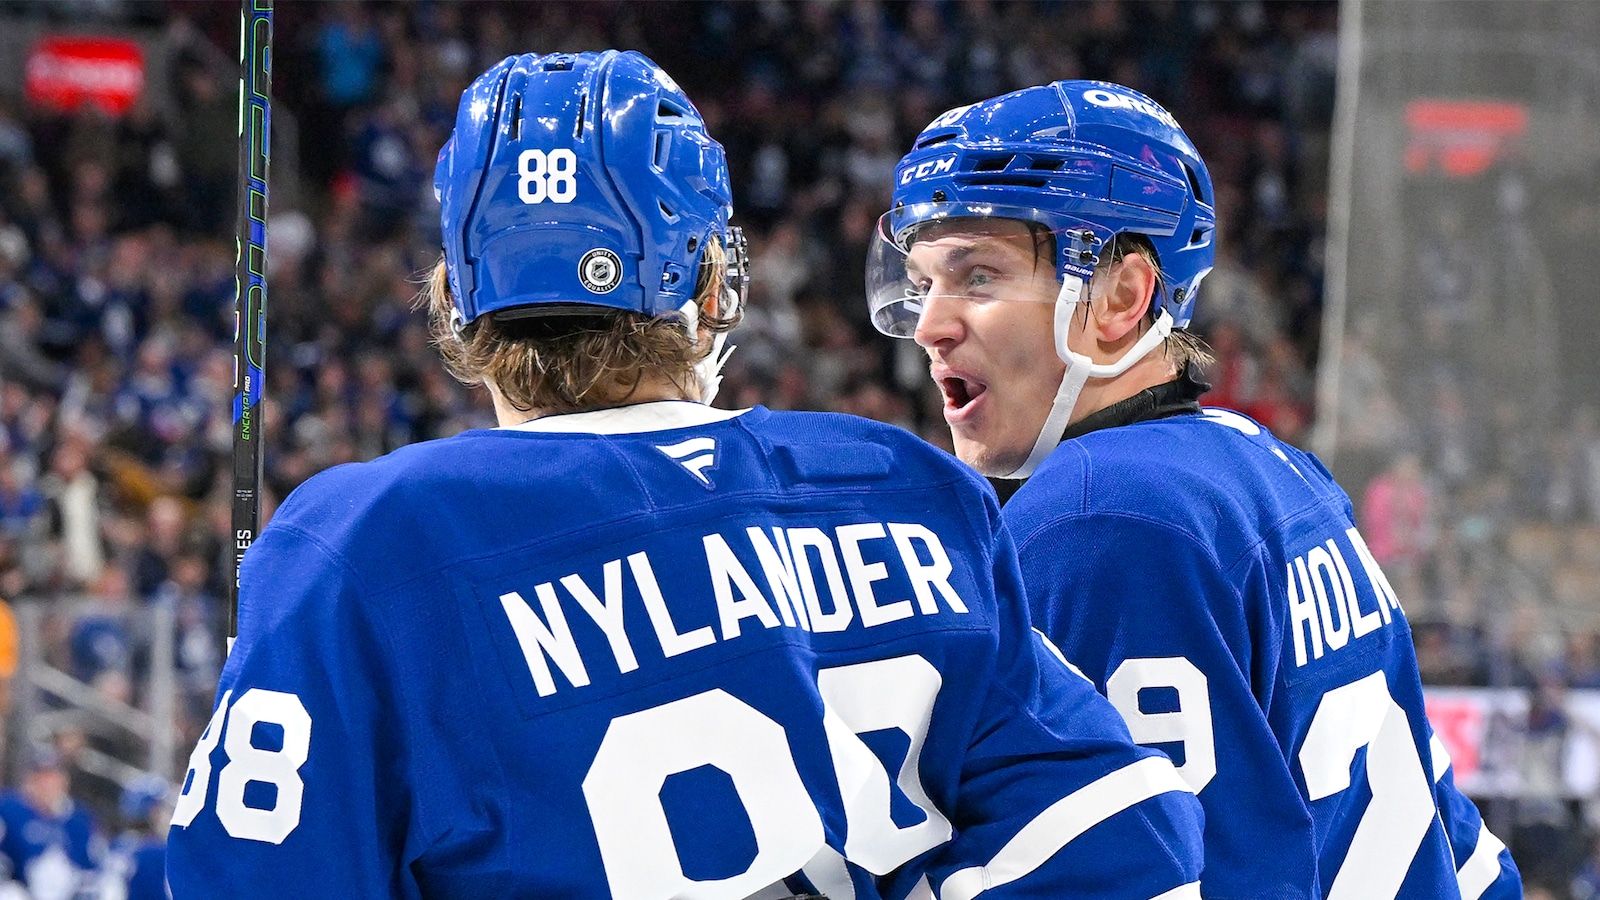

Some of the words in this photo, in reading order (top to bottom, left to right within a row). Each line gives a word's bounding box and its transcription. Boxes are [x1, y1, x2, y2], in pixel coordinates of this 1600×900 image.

[517, 147, 577, 205] 88
[900, 156, 956, 185] CCM
[500, 521, 970, 698] NYLANDER
[169, 687, 313, 846] 88
